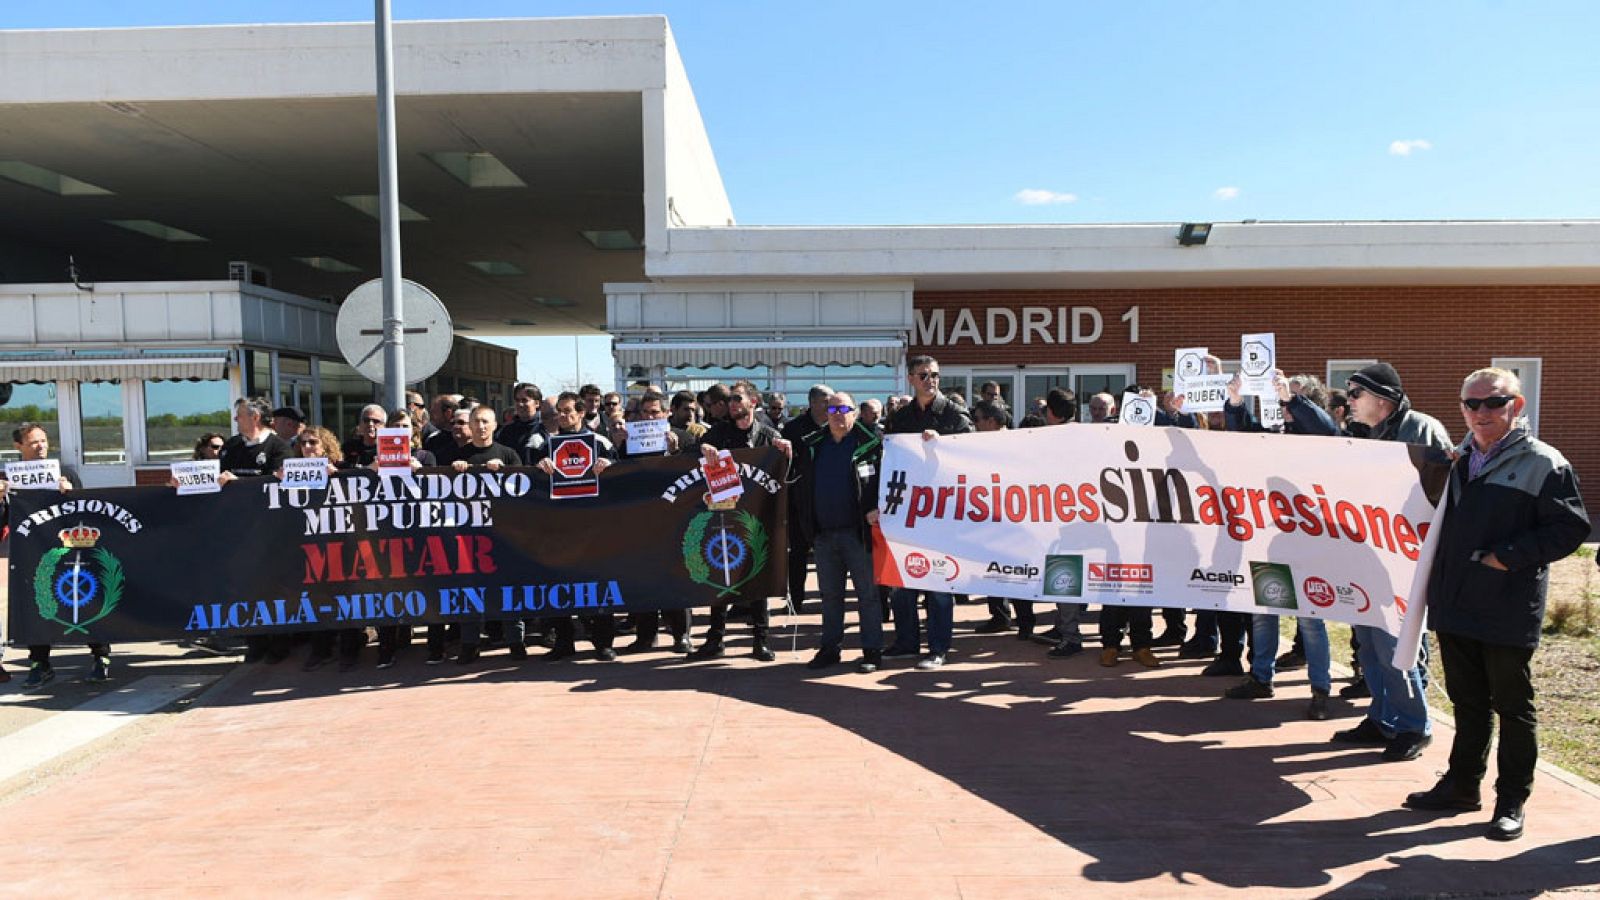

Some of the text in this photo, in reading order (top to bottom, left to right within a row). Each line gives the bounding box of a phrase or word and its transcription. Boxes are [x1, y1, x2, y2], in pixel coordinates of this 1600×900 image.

[909, 306, 1141, 346] MADRID 1
[286, 470, 323, 482] PEAFA
[562, 457, 586, 465] STOP
[263, 472, 532, 509] TU ABANDONO
[661, 462, 782, 504] PRINES
[16, 499, 143, 537] PRISIONES
[303, 500, 493, 535] ME PUEDE
[301, 534, 498, 584] MATAR
[986, 561, 1040, 579] Acaip
[1109, 568, 1149, 578] CCOO
[1190, 568, 1245, 586] Acaip
[185, 580, 625, 631] ALCALÁ-MECO EN LUCHA
